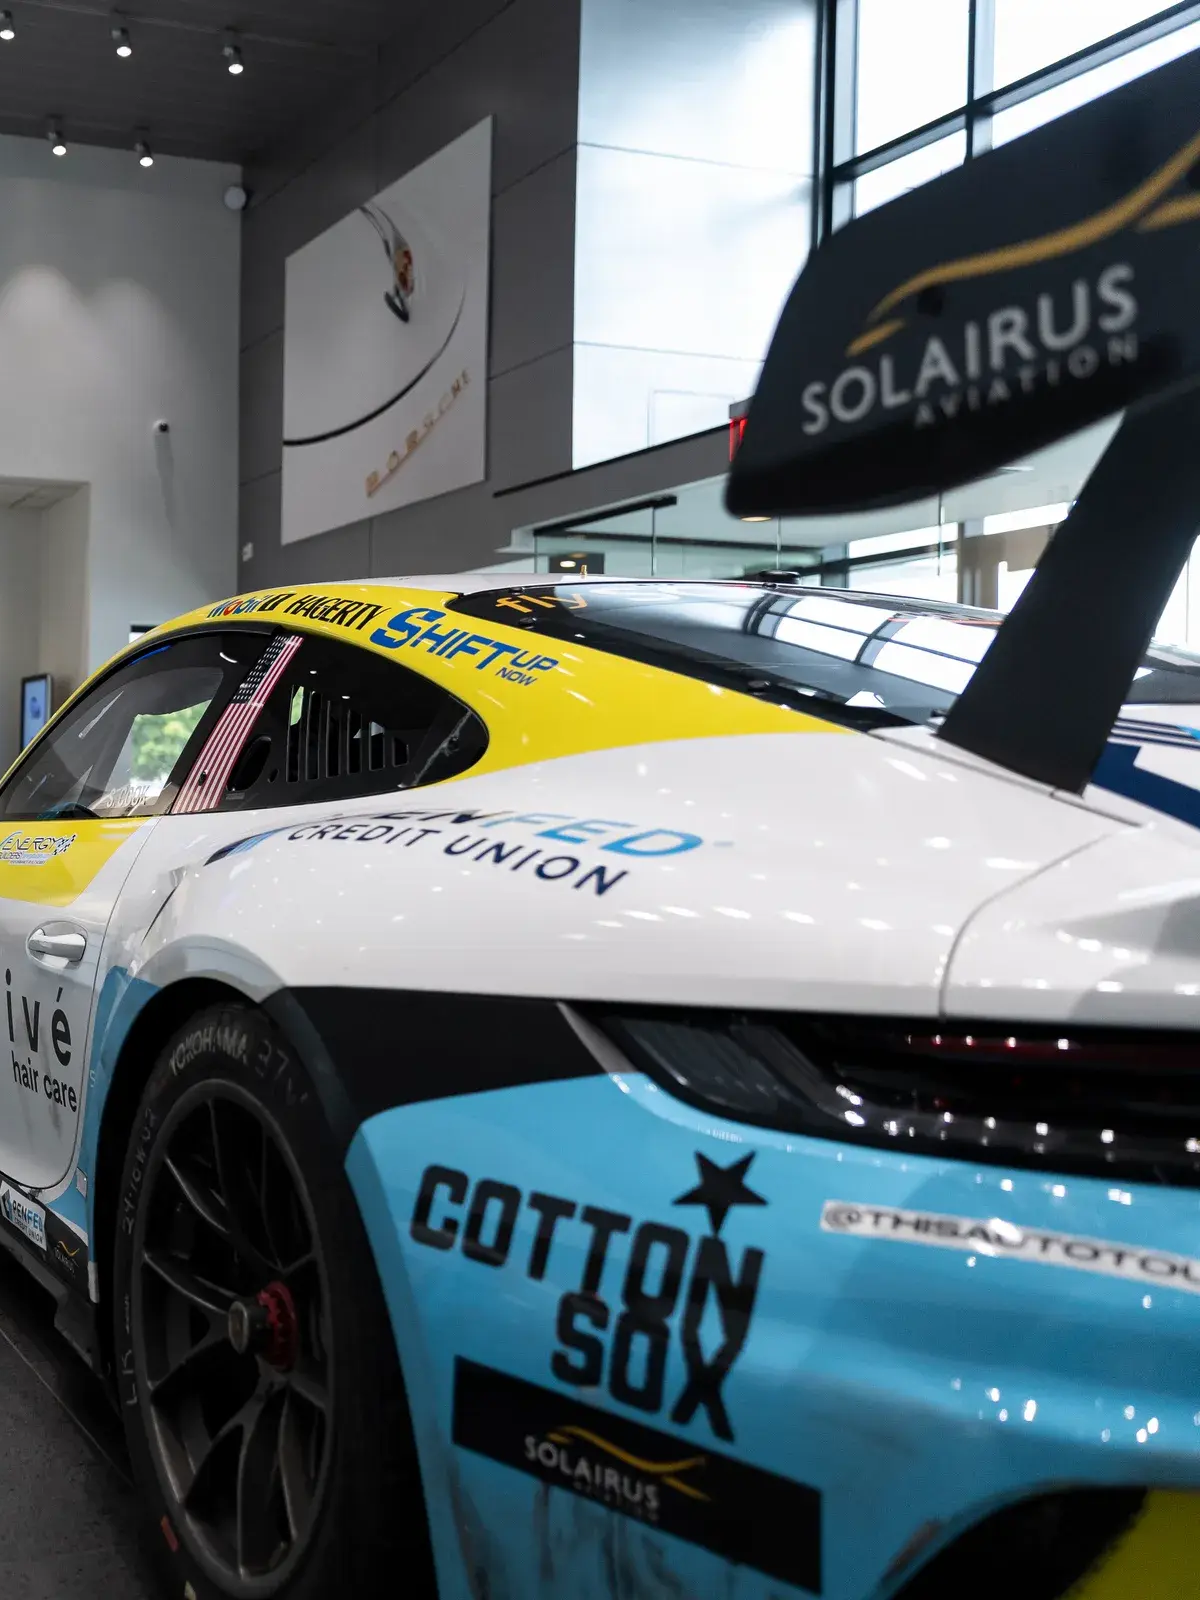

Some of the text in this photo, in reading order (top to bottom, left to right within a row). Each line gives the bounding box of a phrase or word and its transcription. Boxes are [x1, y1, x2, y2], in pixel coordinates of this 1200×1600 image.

[801, 263, 1138, 436] SOLAIRUS
[914, 333, 1138, 428] AVIATION
[283, 594, 392, 631] HAGERTY
[495, 593, 588, 613] fly
[369, 607, 559, 672] SHIFT UP
[495, 667, 538, 687] NOW
[286, 824, 630, 897] CREDIT UNION
[320, 808, 705, 858] ENFED
[11, 1050, 77, 1113] hair care
[168, 1025, 249, 1077] YOKOHAMA
[12, 1199, 43, 1233] PENFED
[28, 1229, 43, 1244] UNION
[409, 1163, 765, 1322] COTTON
[550, 1291, 748, 1443] SOX
[524, 1434, 661, 1511] SOLAIRUS
